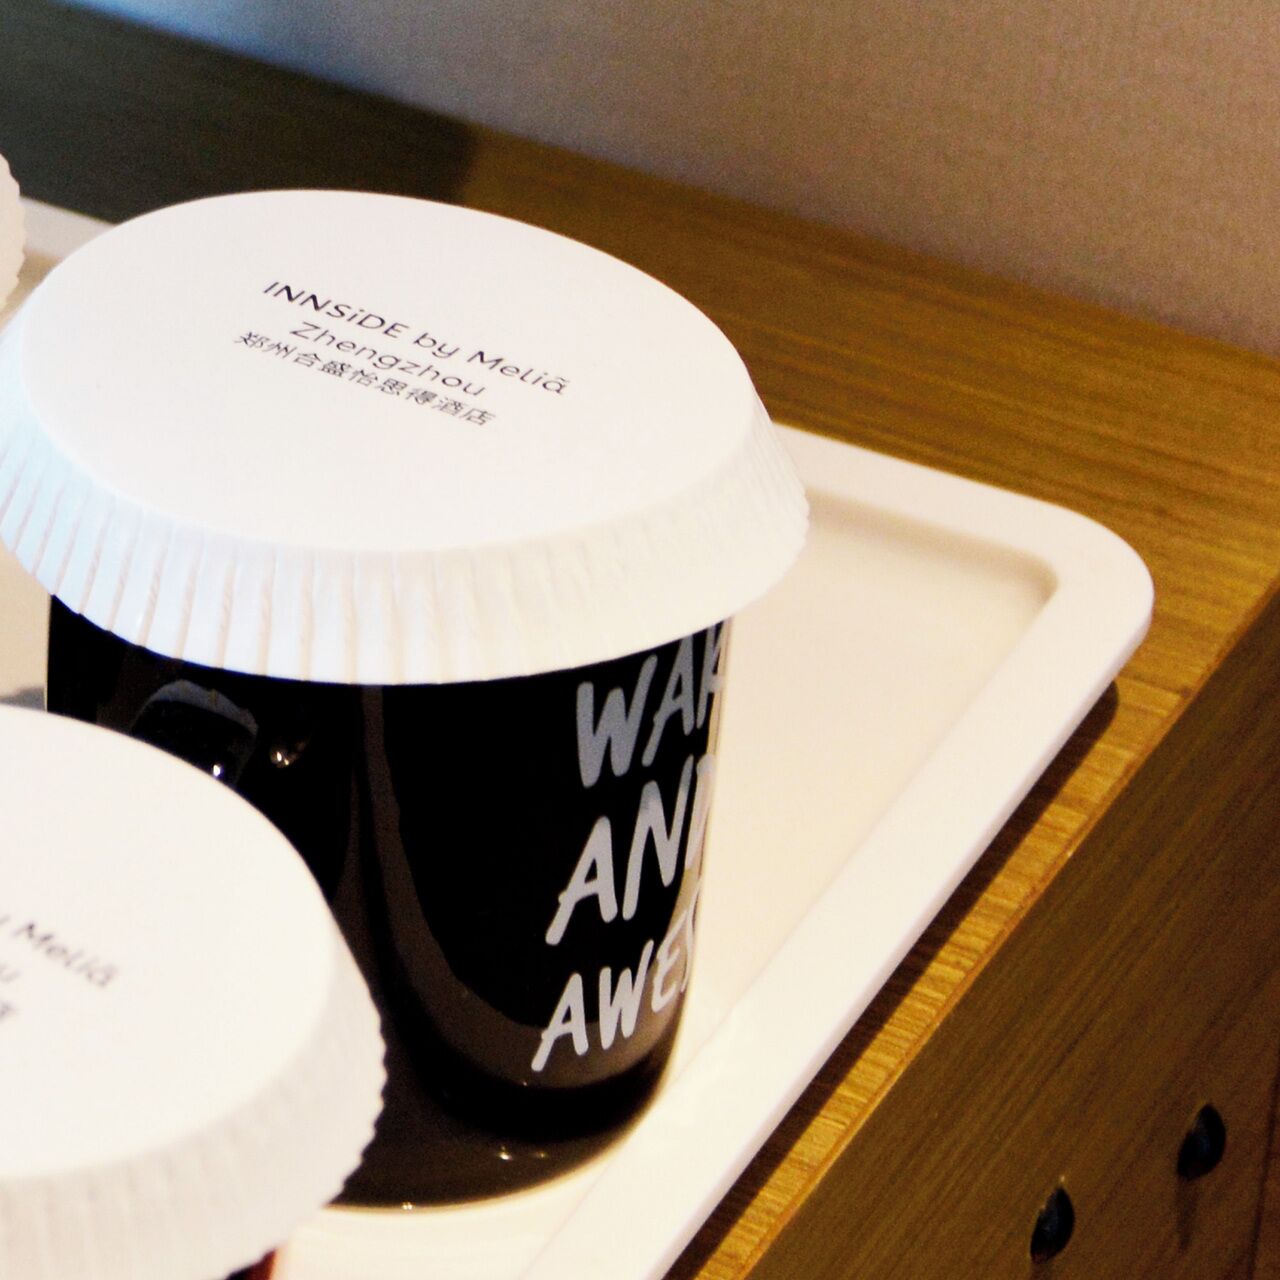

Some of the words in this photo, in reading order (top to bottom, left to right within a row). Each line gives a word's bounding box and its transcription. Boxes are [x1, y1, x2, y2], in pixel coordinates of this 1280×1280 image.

[262, 281, 409, 339] INNSiDE
[413, 332, 461, 359] by
[289, 321, 486, 396] Zhengzhou
